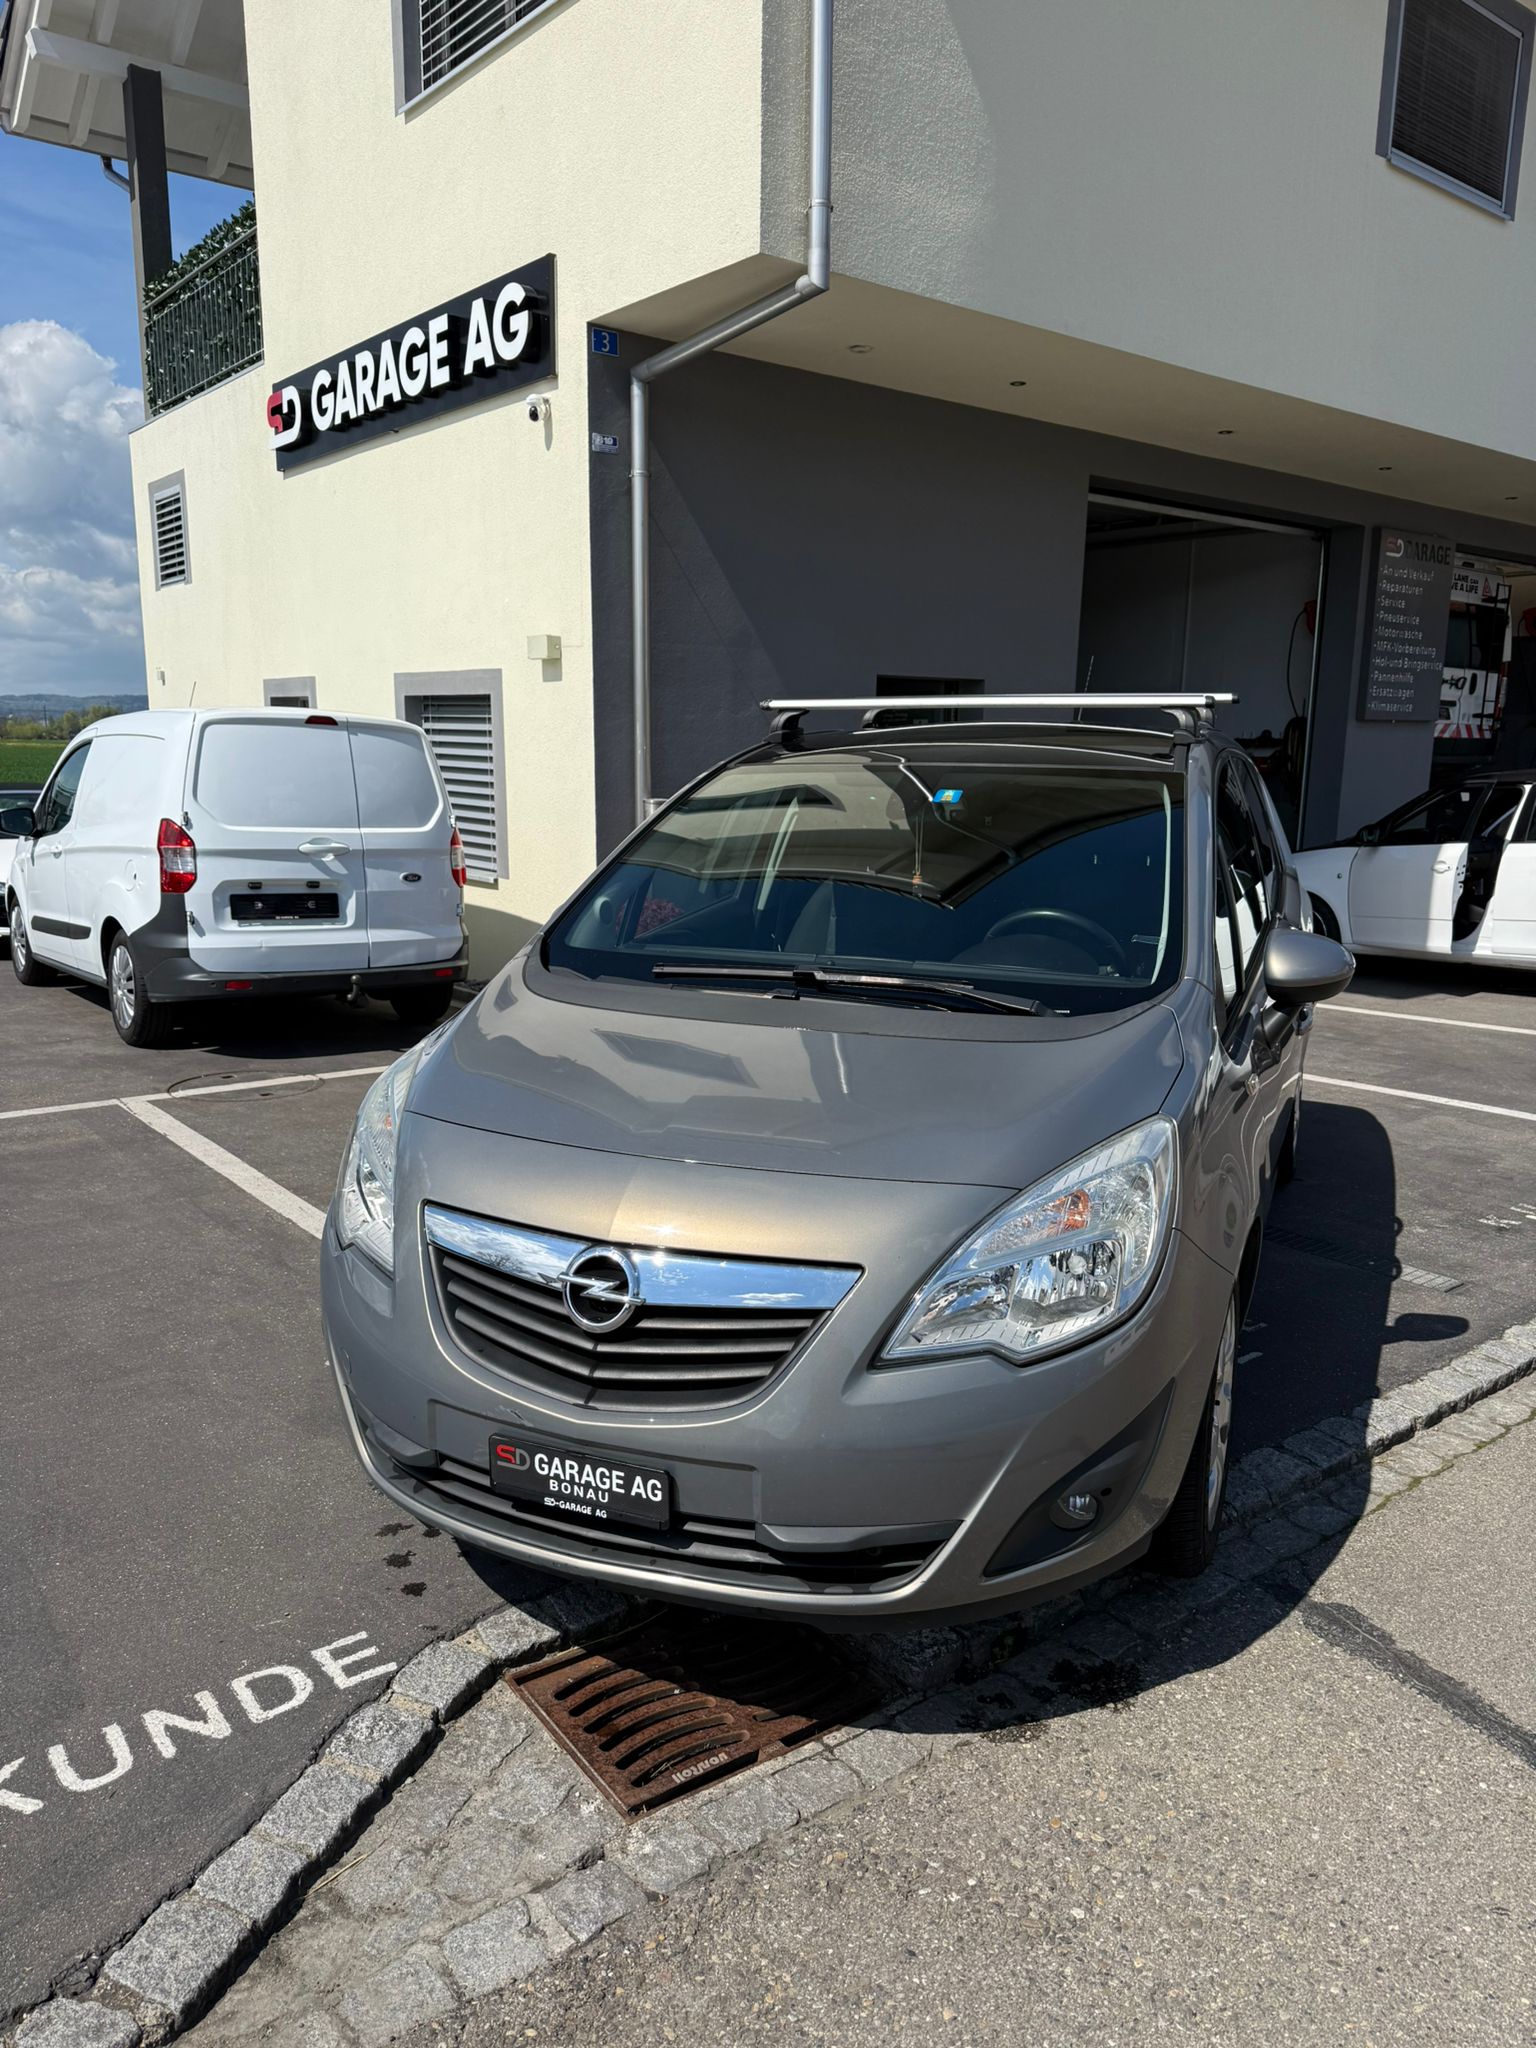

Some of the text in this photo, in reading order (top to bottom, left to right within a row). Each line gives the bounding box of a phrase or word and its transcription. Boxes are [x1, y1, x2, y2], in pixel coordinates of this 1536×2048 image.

[601, 332, 610, 352] 3
[310, 313, 450, 432] GARAGE
[464, 282, 529, 376] AG
[1382, 579, 1424, 595] Reparaturen
[1380, 595, 1406, 609] Service
[1379, 610, 1420, 624] Pneuservice
[1403, 657, 1443, 671] Bringservice
[1373, 670, 1414, 683] Pannenhilfe
[1370, 702, 1413, 713] Klimaservice
[495, 1444, 663, 1502] SD GARAGE AG
[549, 1479, 609, 1503] BONAU
[544, 1497, 607, 1519] SD-GARAGE AG
